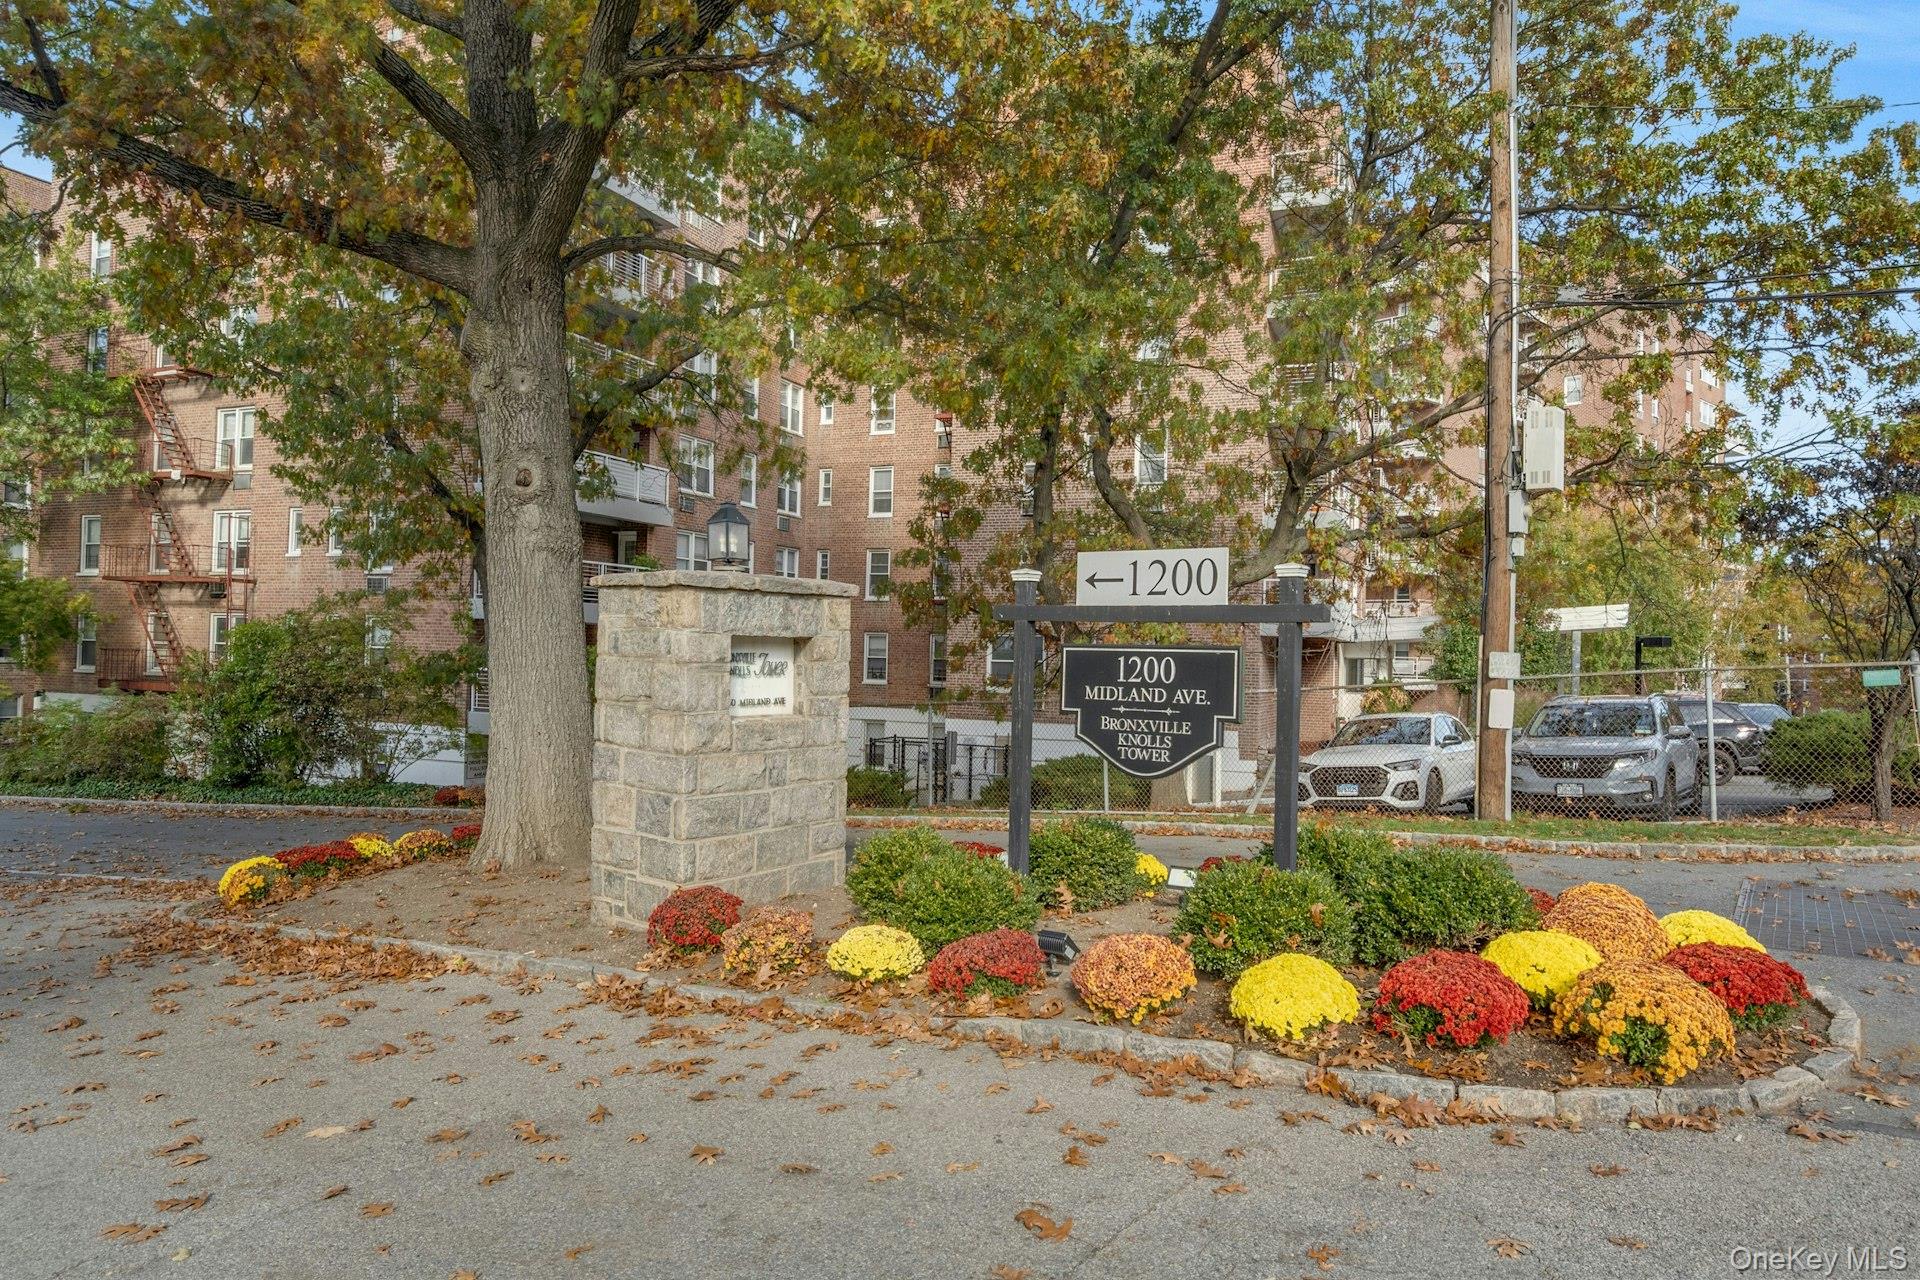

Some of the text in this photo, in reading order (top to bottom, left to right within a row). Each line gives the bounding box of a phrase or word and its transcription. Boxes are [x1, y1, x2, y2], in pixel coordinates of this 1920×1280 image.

[1128, 558, 1218, 596] 1200
[1117, 655, 1176, 684] 1200
[739, 698, 771, 706] MIDLAND
[1084, 685, 1211, 706] MIDLAND AVE.
[1100, 715, 1192, 735] BRONXVILLE
[1118, 734, 1172, 748] KNOLLS
[1117, 746, 1171, 763] TOWER
